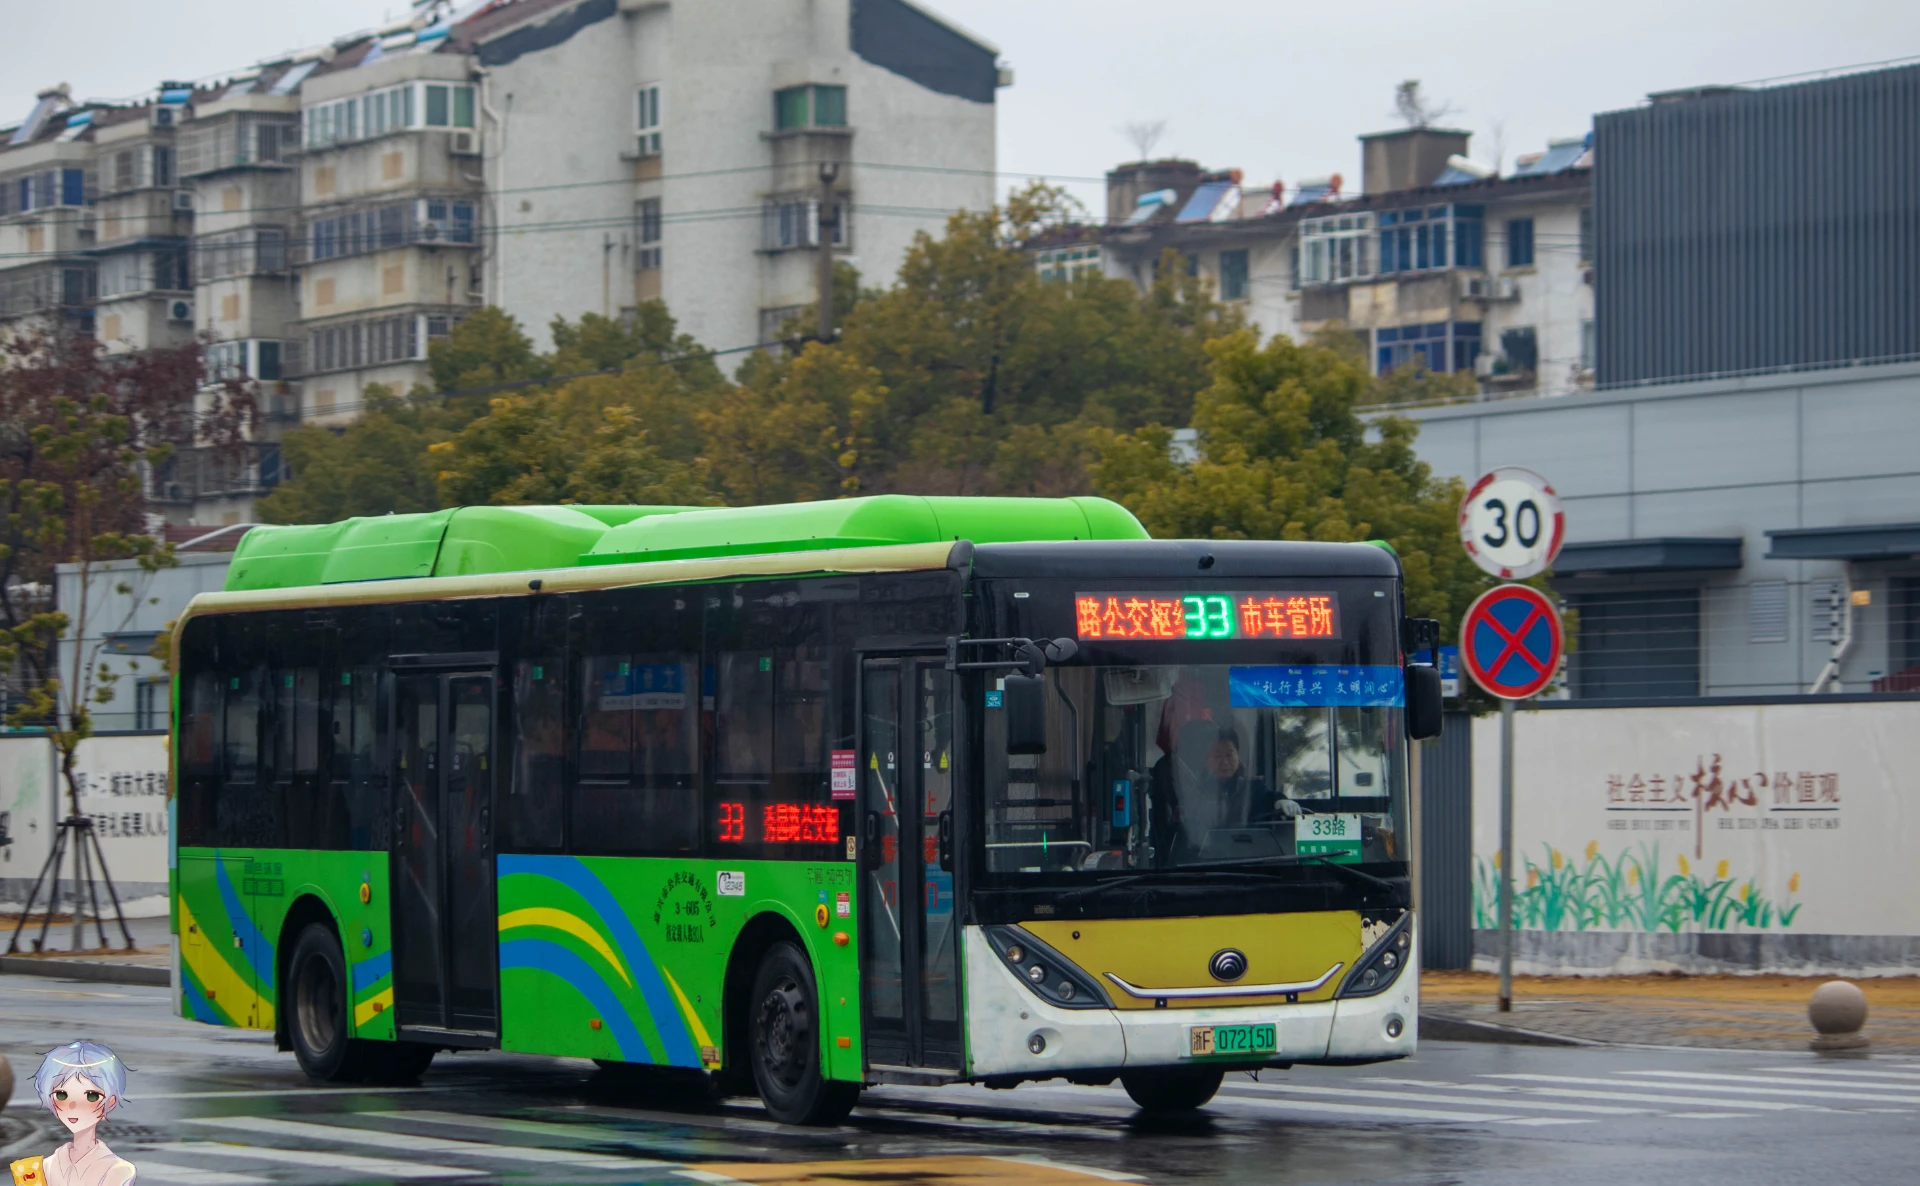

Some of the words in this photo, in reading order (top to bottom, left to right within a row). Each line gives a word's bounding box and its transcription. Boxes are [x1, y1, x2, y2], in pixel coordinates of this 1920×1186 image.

[1482, 497, 1541, 549] 30
[1184, 594, 1233, 639] 33
[1240, 596, 1334, 637] 市车管所
[719, 802, 744, 842] 33
[1312, 818, 1346, 836] 33路
[724, 880, 743, 891] 12345
